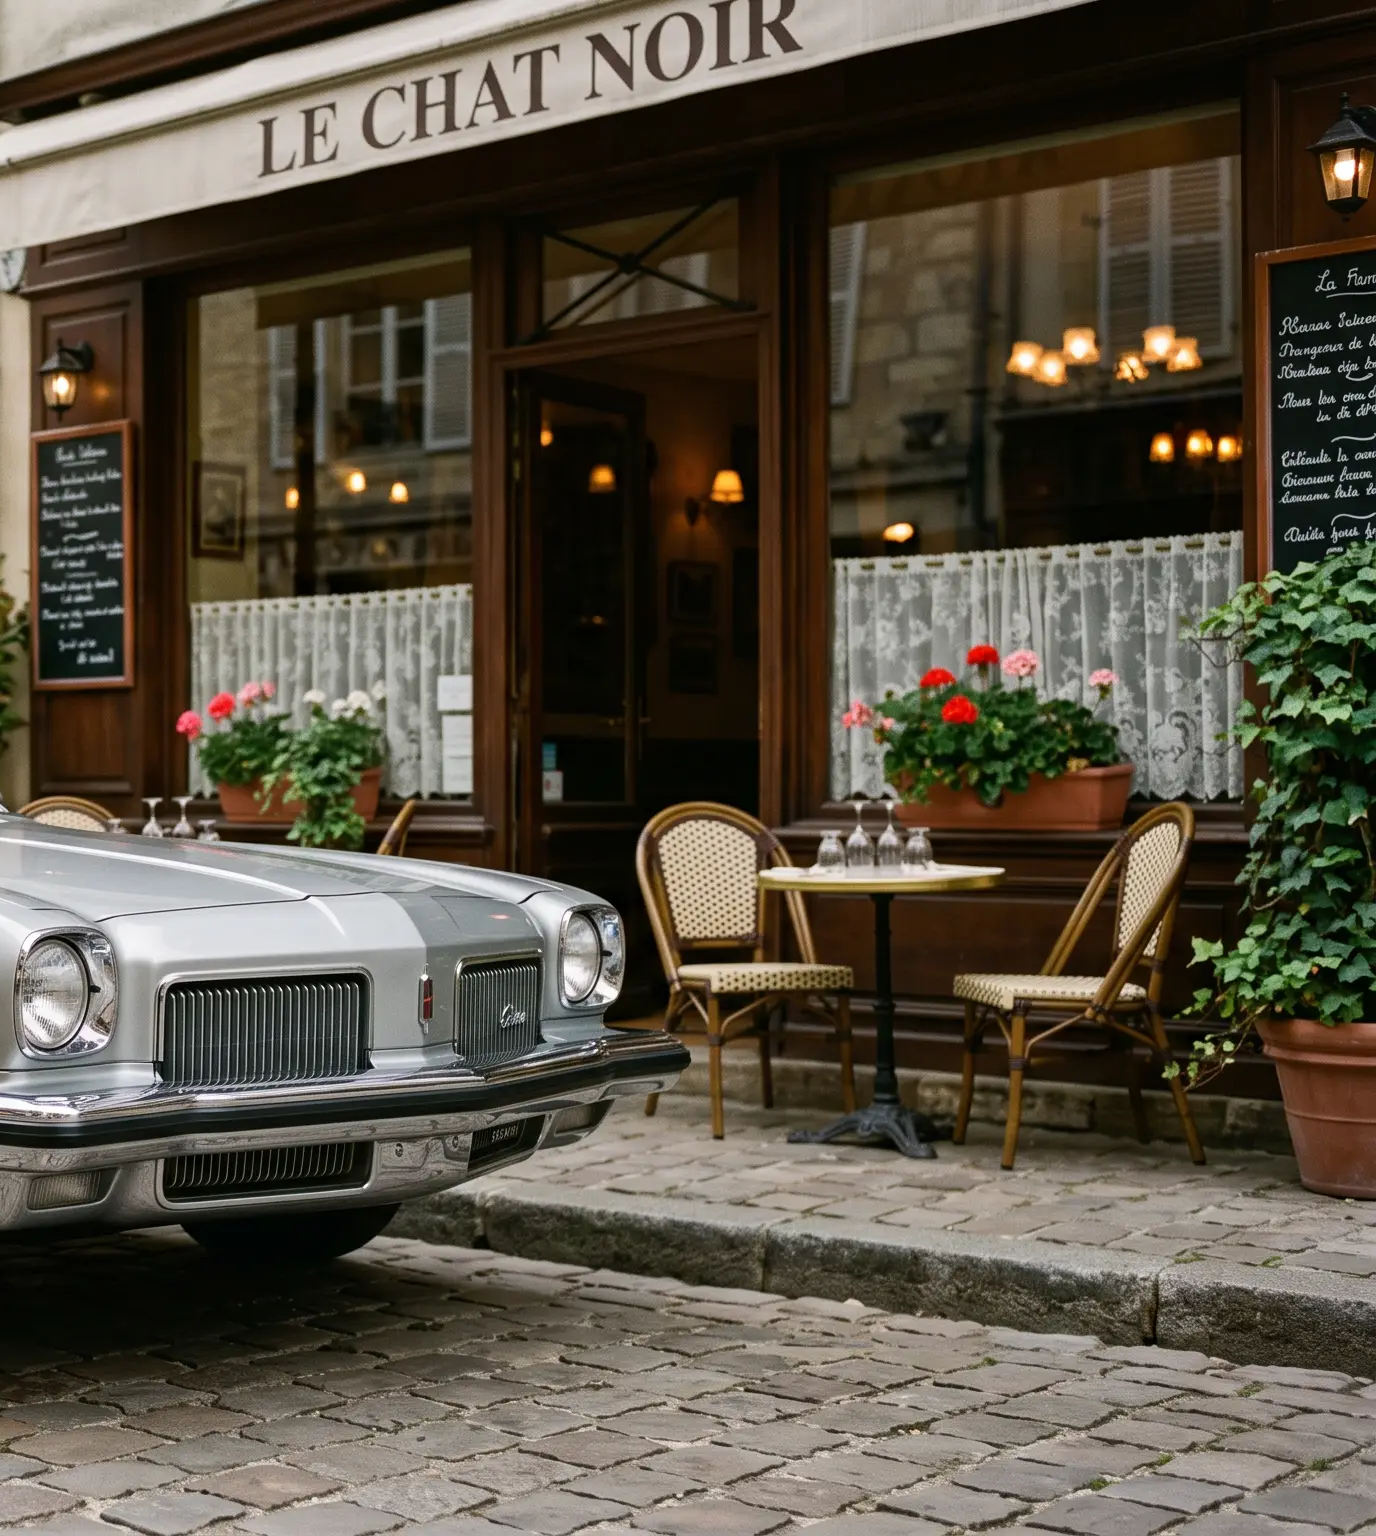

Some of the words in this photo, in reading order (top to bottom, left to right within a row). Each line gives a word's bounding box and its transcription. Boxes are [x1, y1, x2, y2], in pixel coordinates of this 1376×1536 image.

[258, 101, 340, 178] LE
[362, 43, 561, 150] CHAT
[584, 0, 803, 100] NOIR
[1315, 269, 1337, 292] La
